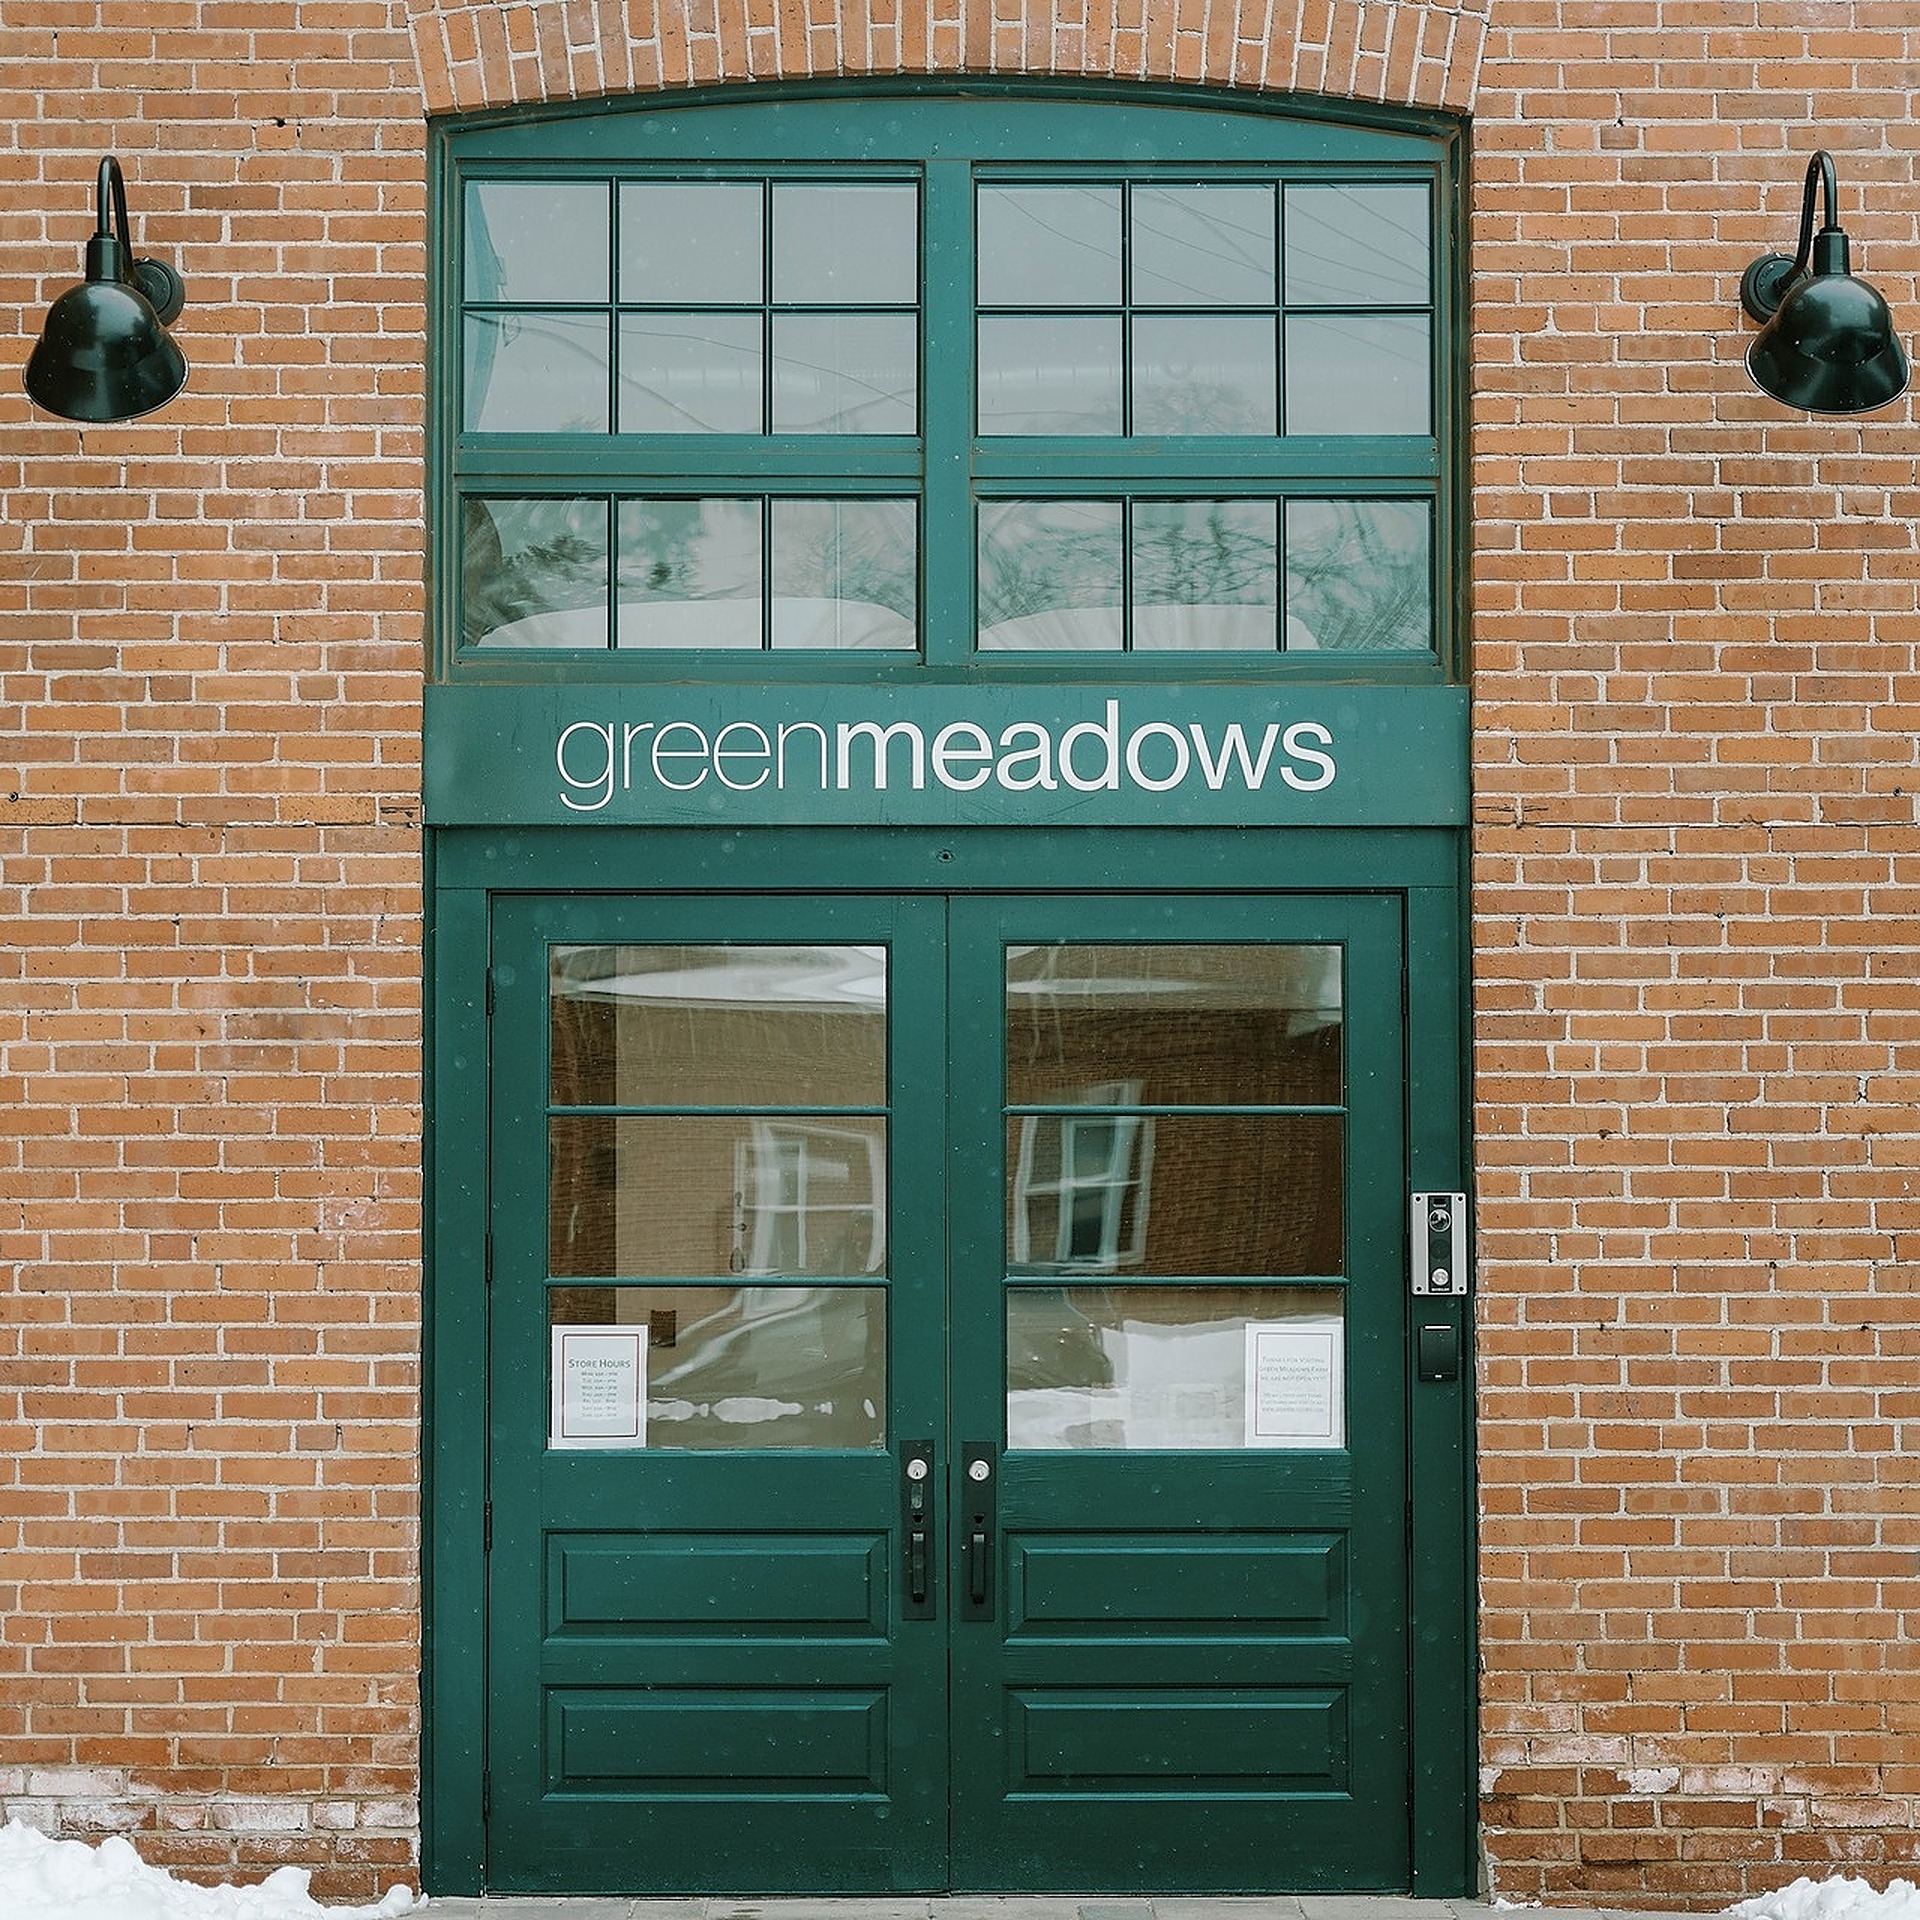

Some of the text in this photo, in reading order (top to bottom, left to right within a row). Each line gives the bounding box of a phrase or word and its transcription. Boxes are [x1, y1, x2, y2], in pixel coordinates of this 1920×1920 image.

[556, 699, 1337, 811] greenmeadows
[568, 1358, 631, 1369] STORE HOURS
